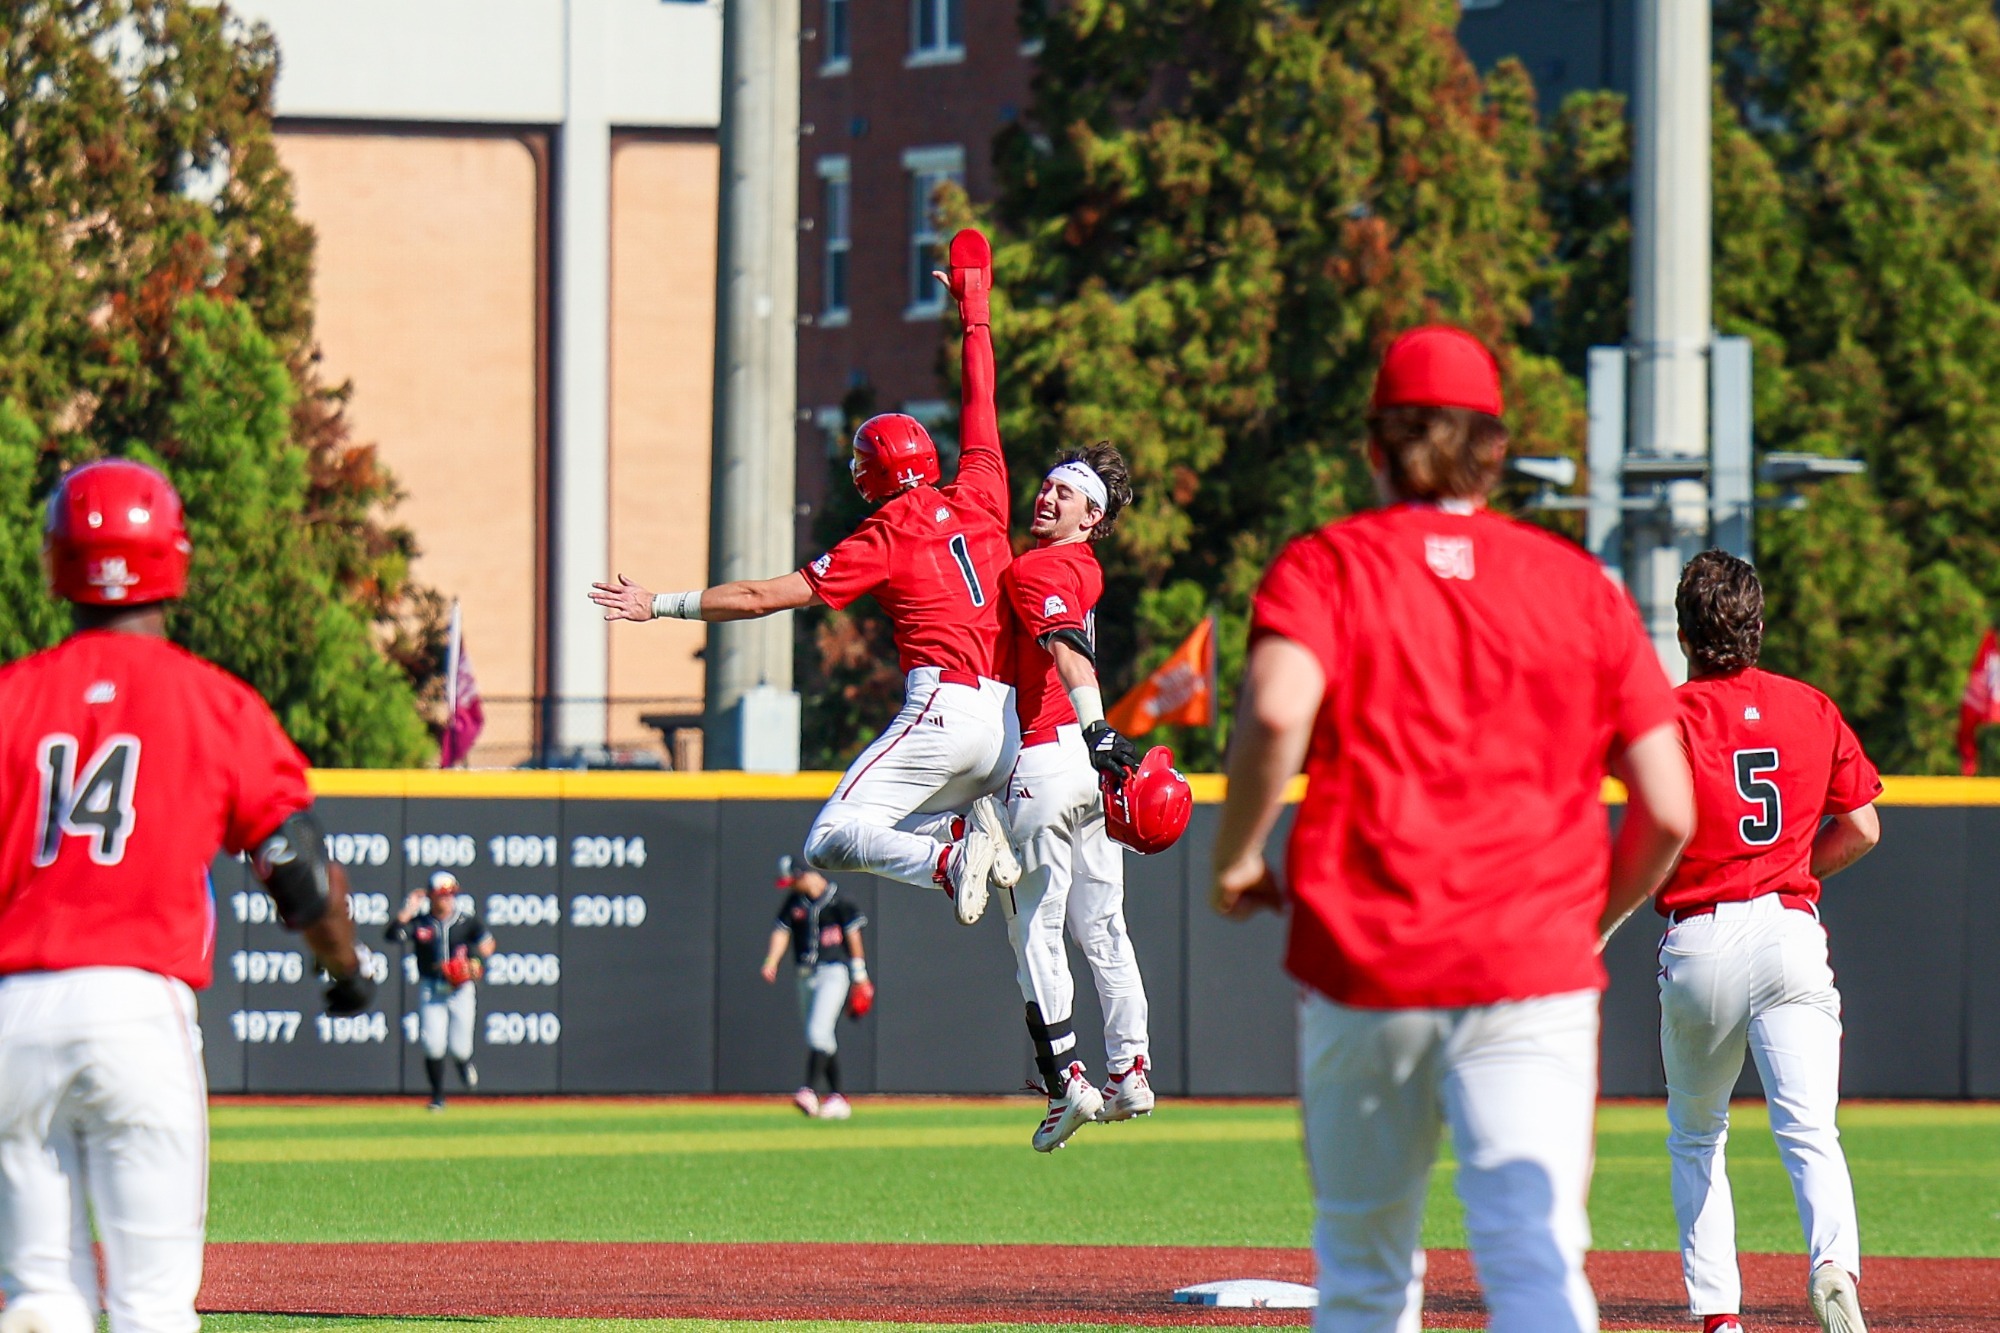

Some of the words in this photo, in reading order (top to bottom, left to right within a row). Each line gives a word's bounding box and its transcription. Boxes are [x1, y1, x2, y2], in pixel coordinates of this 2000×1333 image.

[948, 533, 985, 608] 1
[32, 732, 142, 868] 14
[1732, 747, 1783, 846] 5
[323, 833, 390, 866] 1979
[404, 834, 476, 866] 1986
[489, 834, 557, 867] 1991
[571, 836, 647, 868] 2014
[486, 893, 561, 926] 2004
[571, 894, 647, 927] 2019
[231, 950, 303, 984] 1976
[486, 952, 560, 986] 2006
[231, 1010, 303, 1043] 1977
[316, 1011, 389, 1044] 1984
[486, 1011, 561, 1045] 2010
